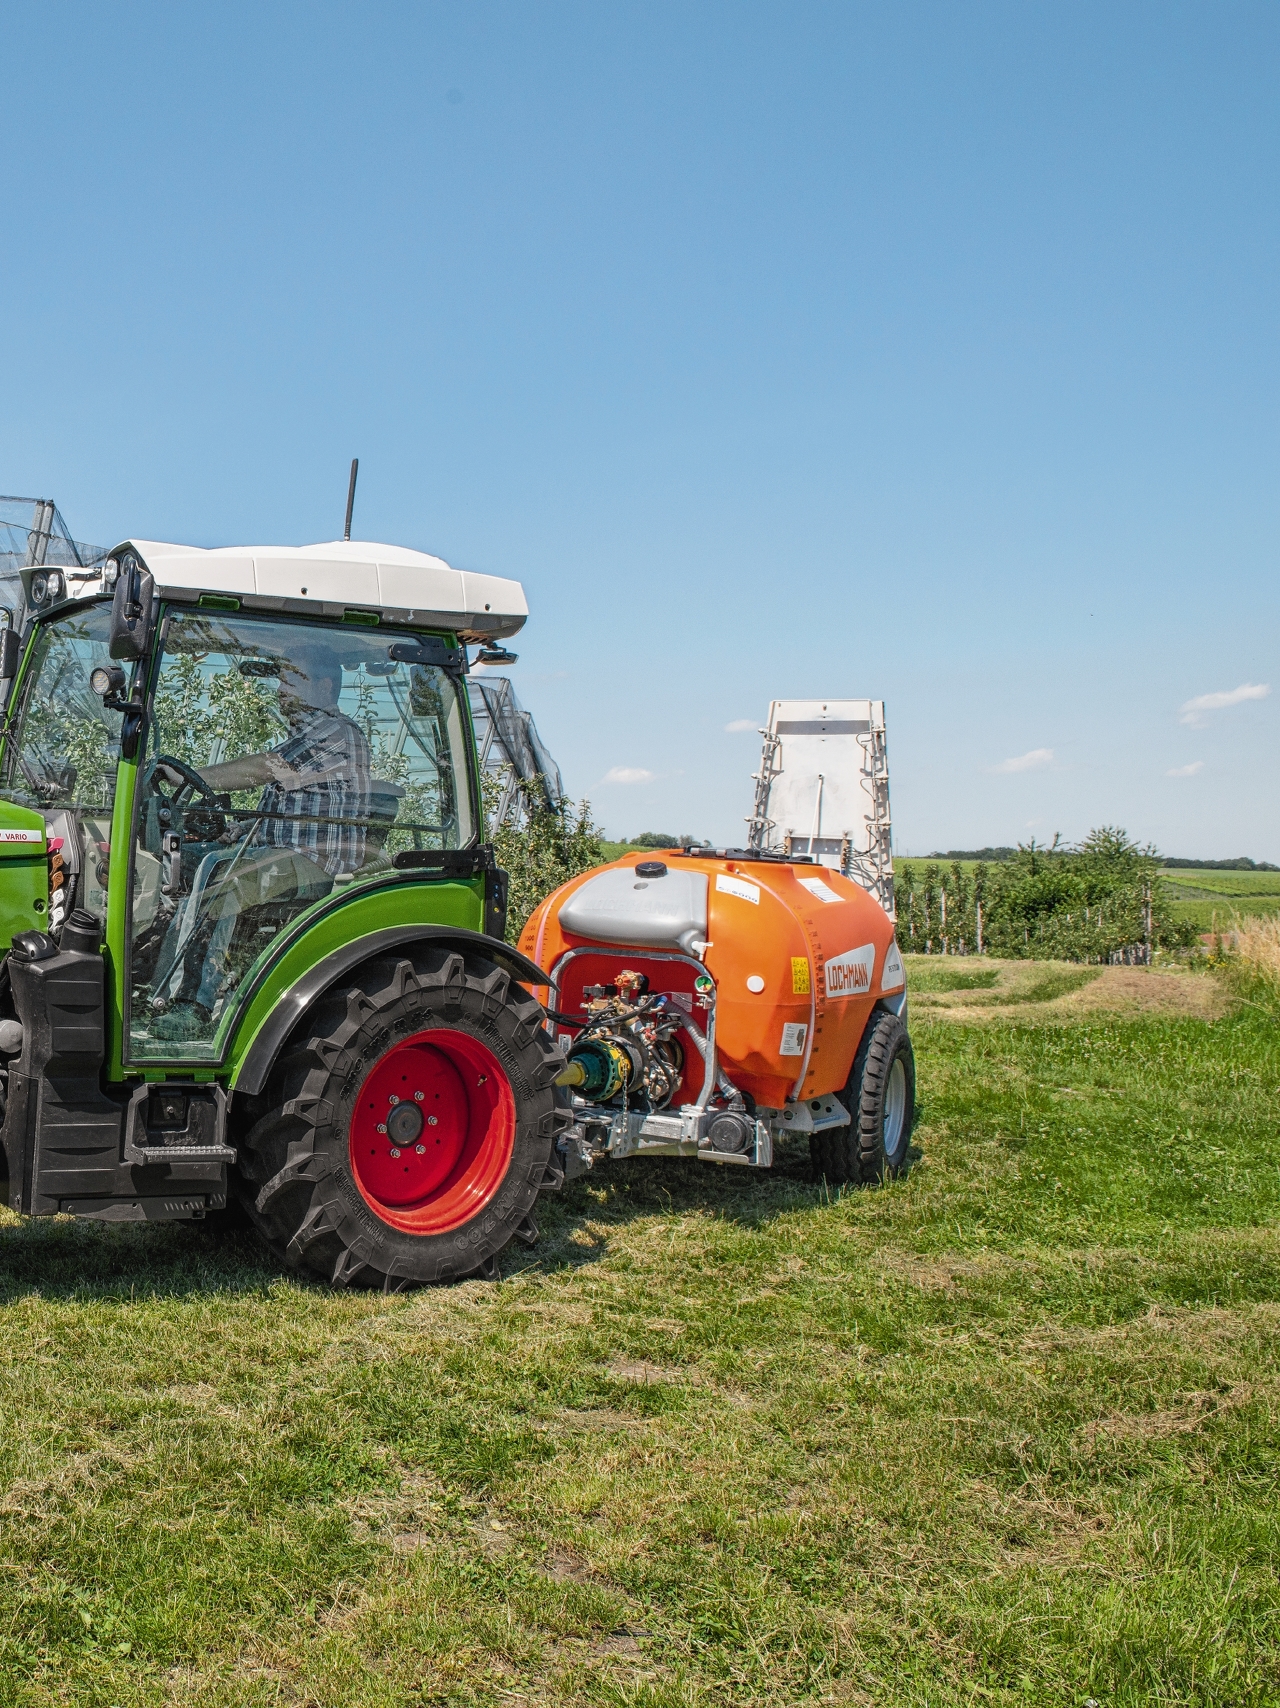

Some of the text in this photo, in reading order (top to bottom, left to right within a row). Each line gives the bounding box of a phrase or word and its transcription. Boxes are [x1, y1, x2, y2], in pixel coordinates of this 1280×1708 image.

[5, 833, 28, 841] VARIO
[827, 962, 869, 992] LOCHMANN
[482, 1019, 535, 1101] TRELLEBORG
[333, 1165, 387, 1248] TRELLEBORG
